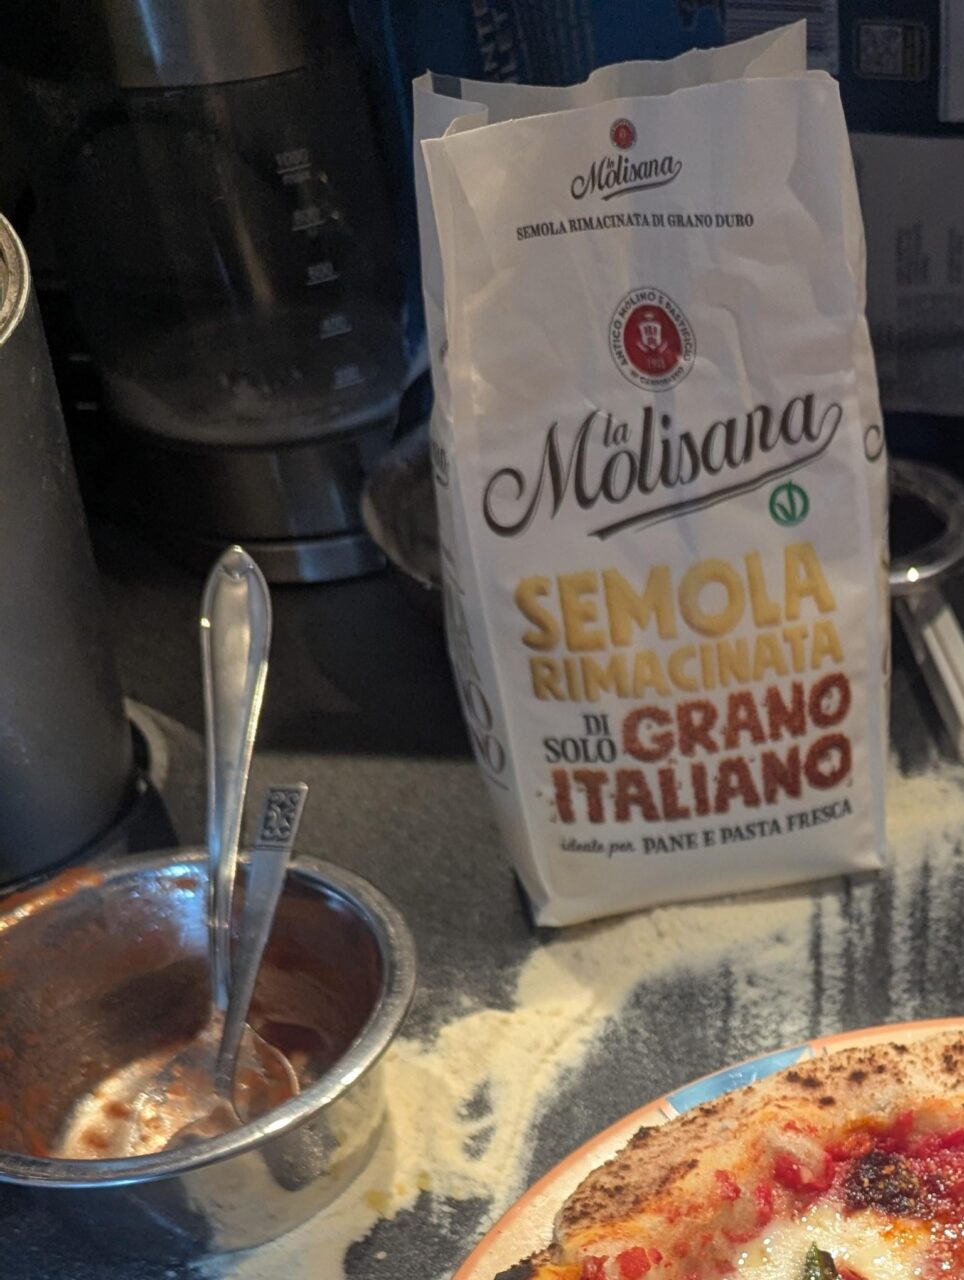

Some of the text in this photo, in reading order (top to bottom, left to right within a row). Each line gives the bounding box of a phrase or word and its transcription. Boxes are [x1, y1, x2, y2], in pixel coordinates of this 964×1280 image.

[570, 155, 682, 200] Molisana
[516, 213, 755, 241] SEMOLA RIMACINATA DI GRANO DURO
[618, 291, 656, 318] MOLINO
[612, 320, 628, 366] ANTICO
[603, 413, 632, 448] la
[483, 393, 843, 541] Molisana
[514, 541, 838, 653] SEMOLA
[529, 619, 845, 702] RIMACINATA
[582, 714, 611, 738] DI
[621, 672, 853, 764] GRANO
[543, 737, 617, 765] SOLO
[550, 732, 854, 825] ITALIANO
[641, 832, 698, 855] PANE
[702, 829, 716, 848] E
[719, 818, 782, 845] PASTA
[785, 798, 854, 832] FRESCA
